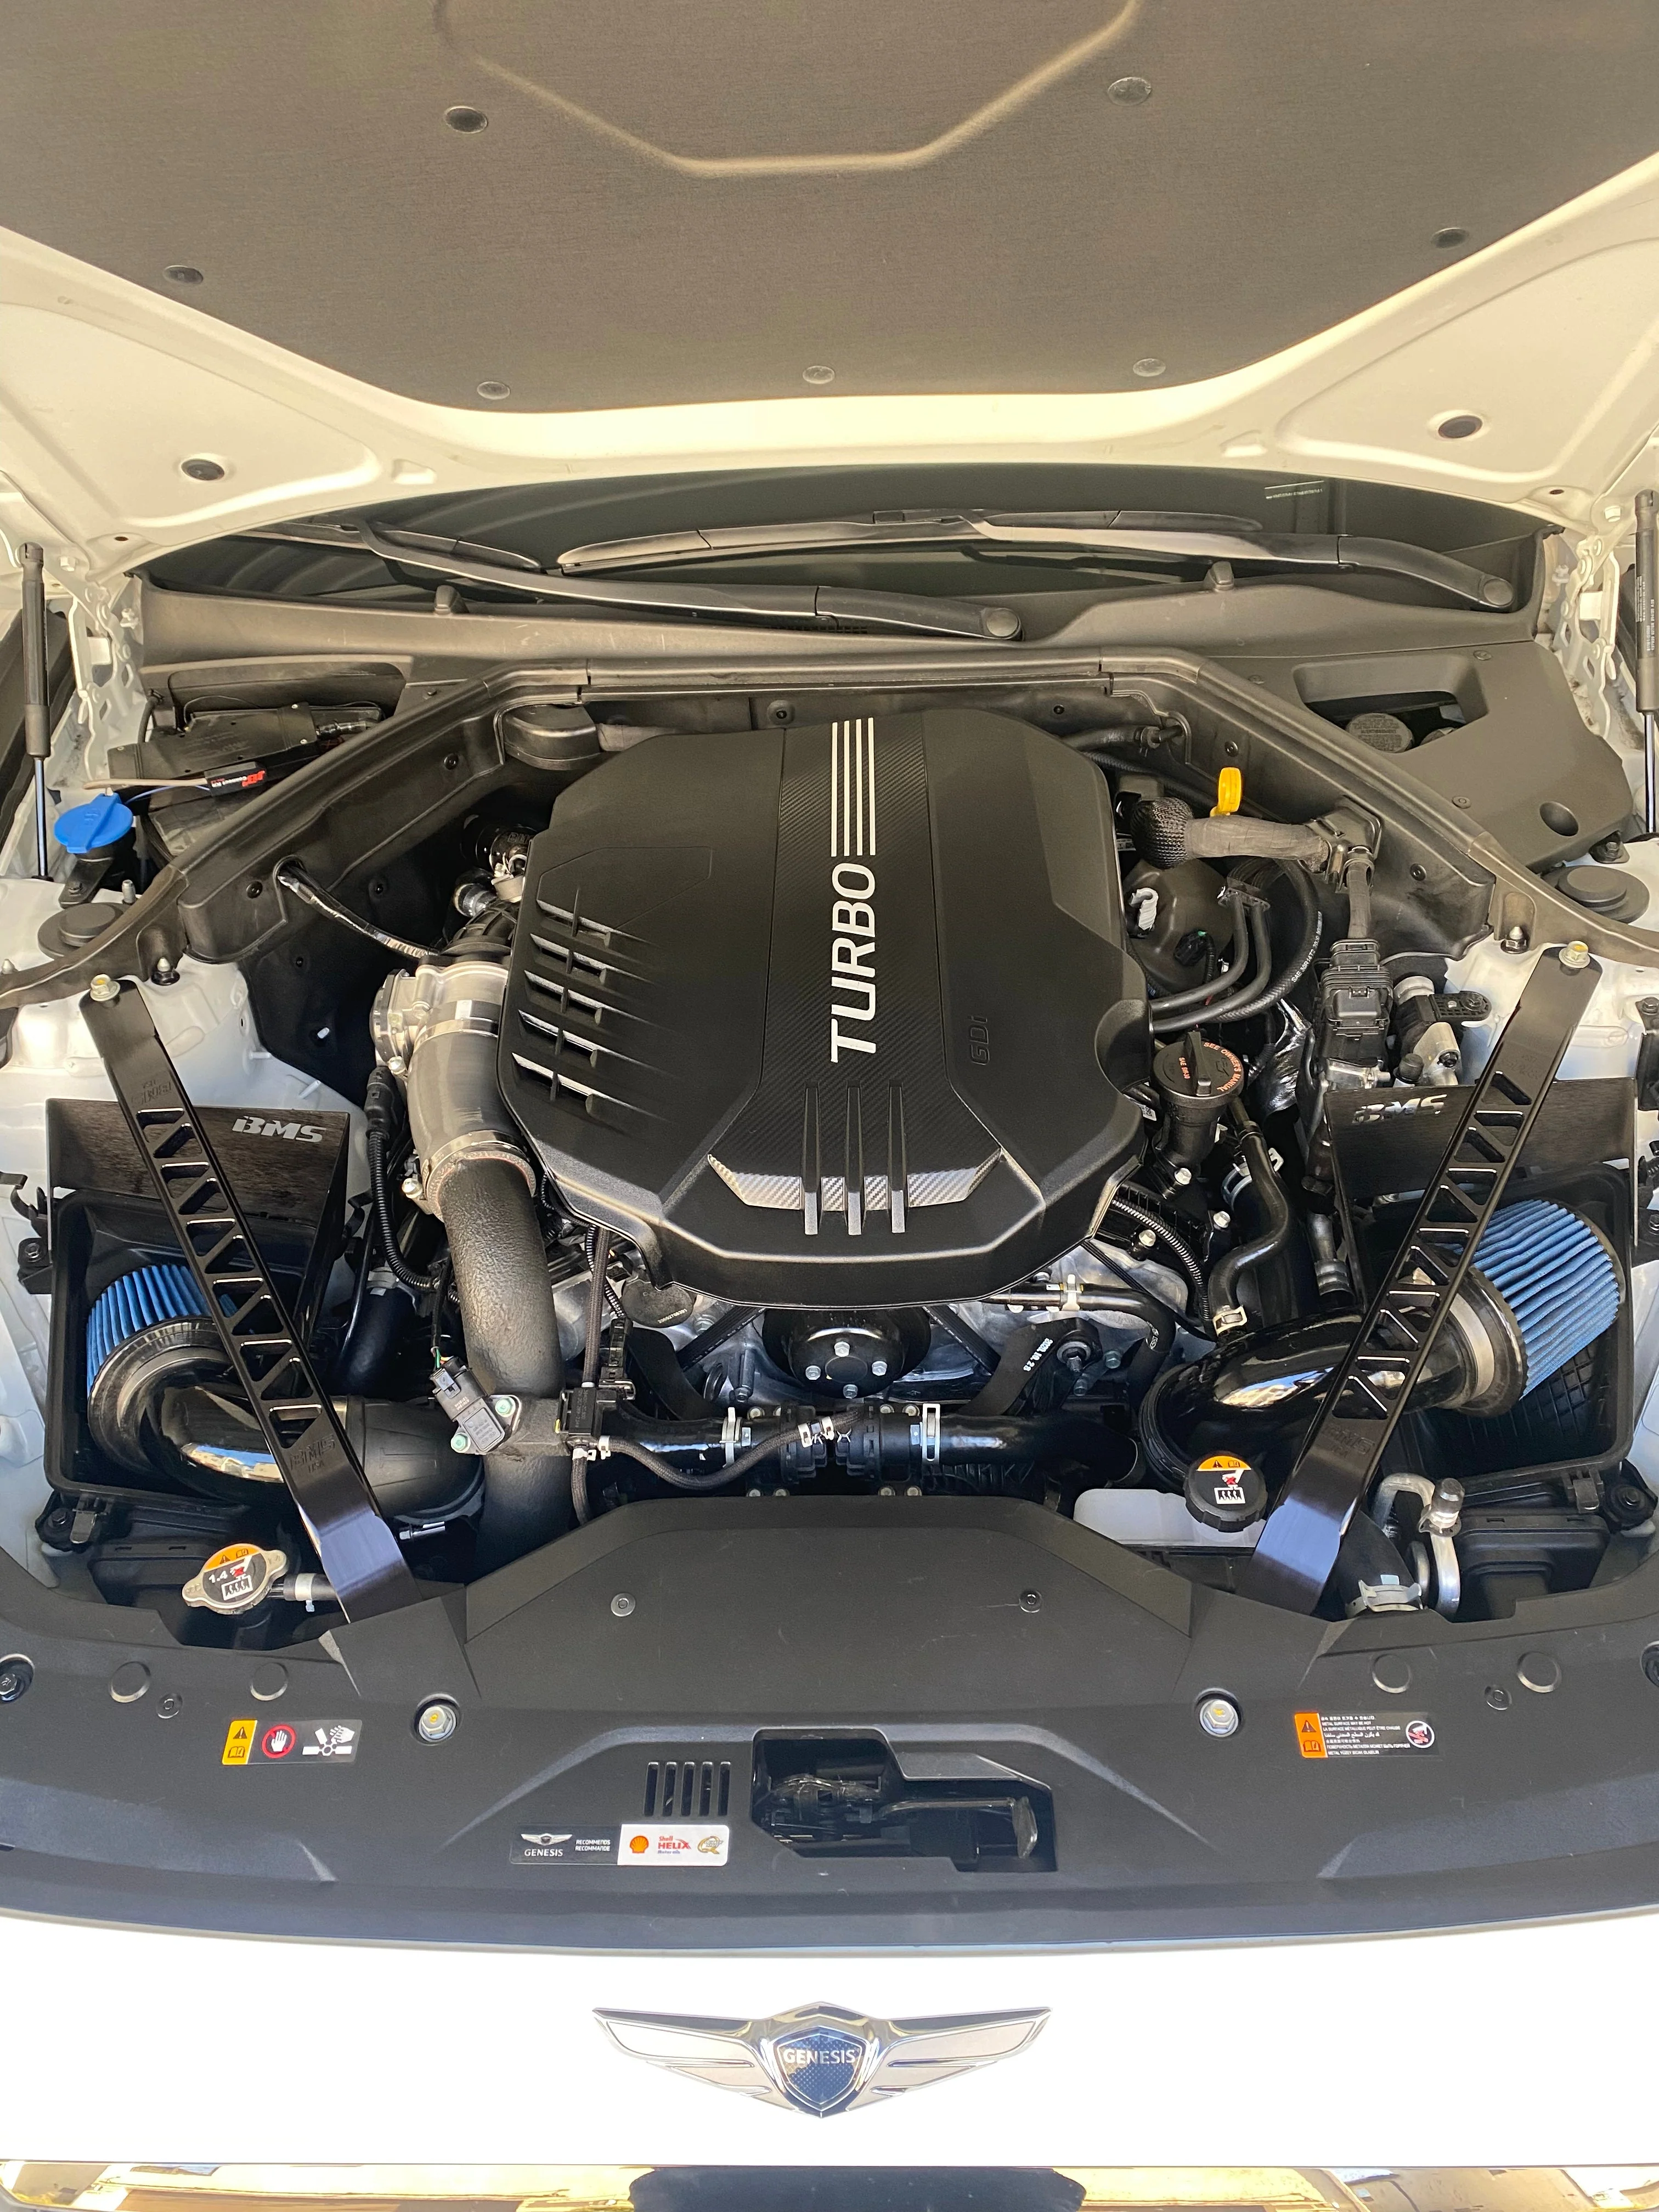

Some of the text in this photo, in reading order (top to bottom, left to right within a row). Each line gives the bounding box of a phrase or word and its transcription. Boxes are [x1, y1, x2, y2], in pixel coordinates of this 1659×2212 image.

[831, 863, 876, 1063] TURBO
[1291, 970, 1302, 983] SAE
[1204, 1042, 1242, 1092] SEE OWNER'S MANUAL
[232, 1115, 327, 1143] BMS
[208, 1570, 228, 1583] 1.4
[658, 1841, 691, 1849] HELIX
[524, 1848, 563, 1857] GENESIS
[782, 2048, 856, 2064] GENESIS
